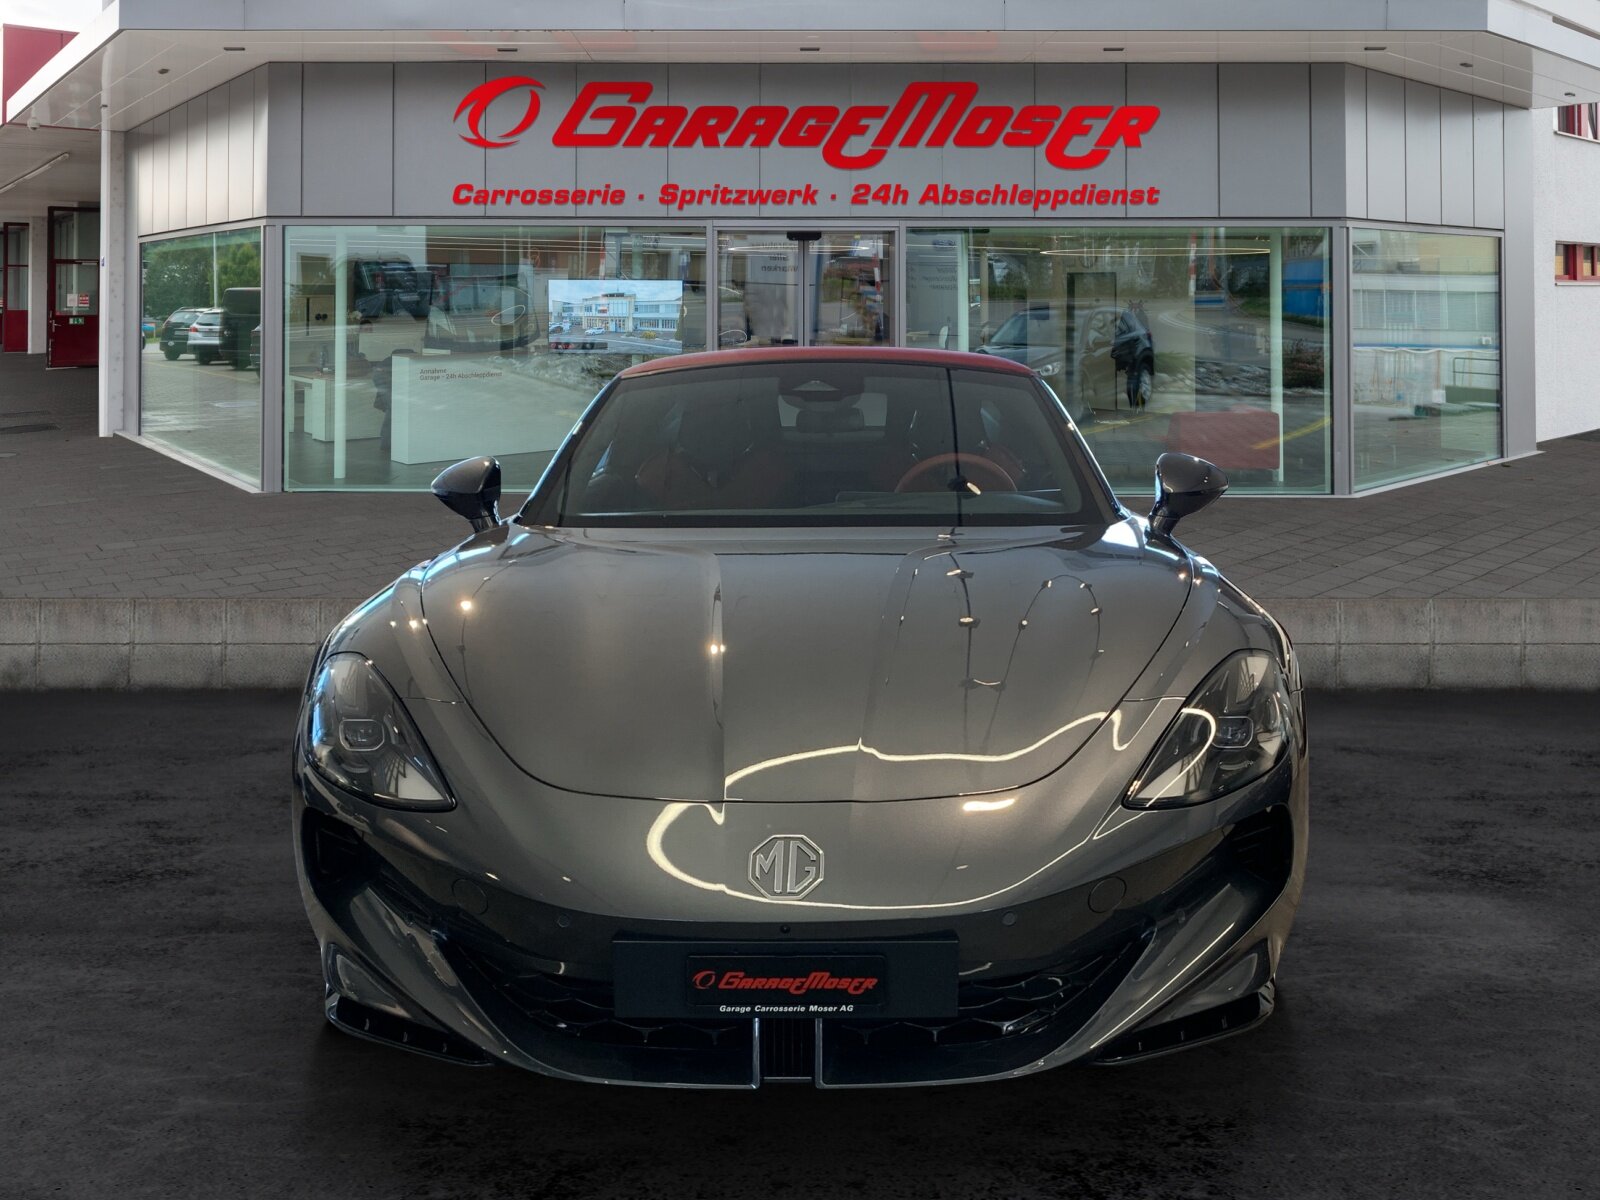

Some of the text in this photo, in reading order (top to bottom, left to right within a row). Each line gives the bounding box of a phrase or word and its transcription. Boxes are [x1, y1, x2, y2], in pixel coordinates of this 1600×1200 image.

[452, 183, 625, 205] Carrosserie
[659, 183, 818, 210] Spritzwerk
[850, 183, 909, 205] 24h
[918, 183, 1160, 210] Abschleppdienst
[756, 840, 816, 893] MG
[719, 1003, 854, 1014] Garage Carrosserie Moser AG
